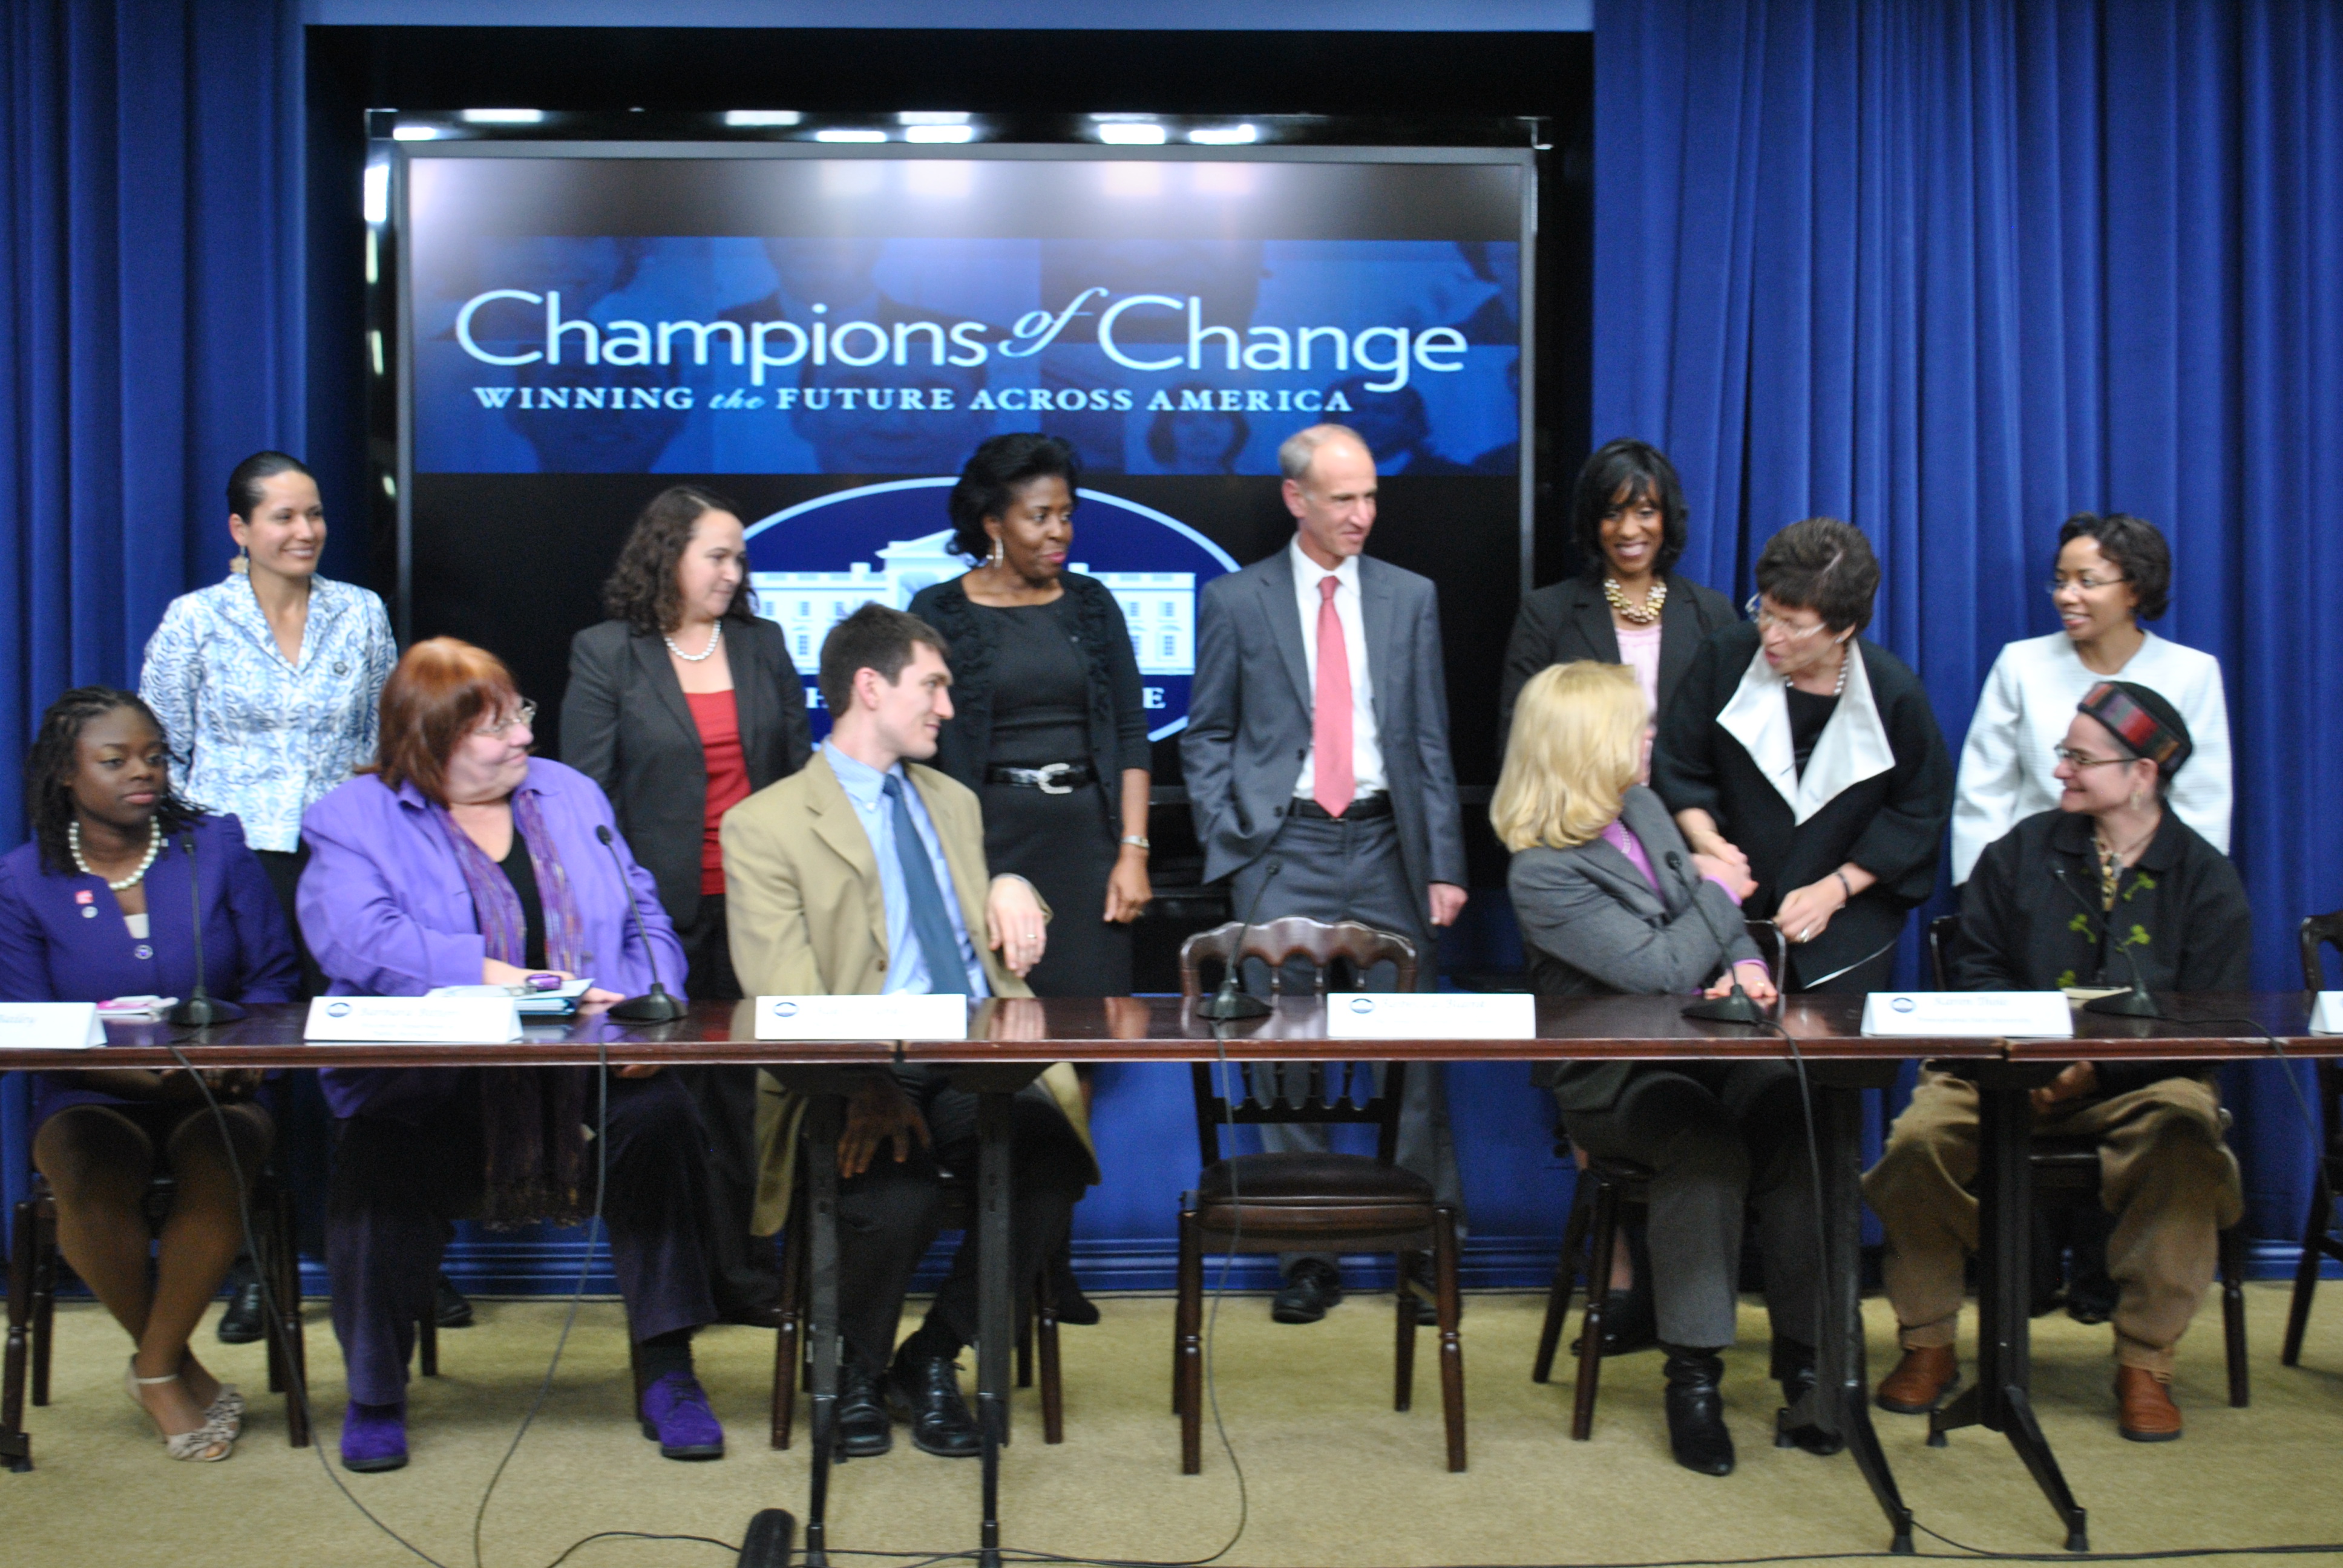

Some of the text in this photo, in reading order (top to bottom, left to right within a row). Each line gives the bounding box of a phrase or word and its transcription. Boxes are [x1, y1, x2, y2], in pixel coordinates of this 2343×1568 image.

[455, 287, 1467, 392] Champions of Change
[474, 387, 1352, 412] WINNING the FUTURE ACROSS AMERICA
